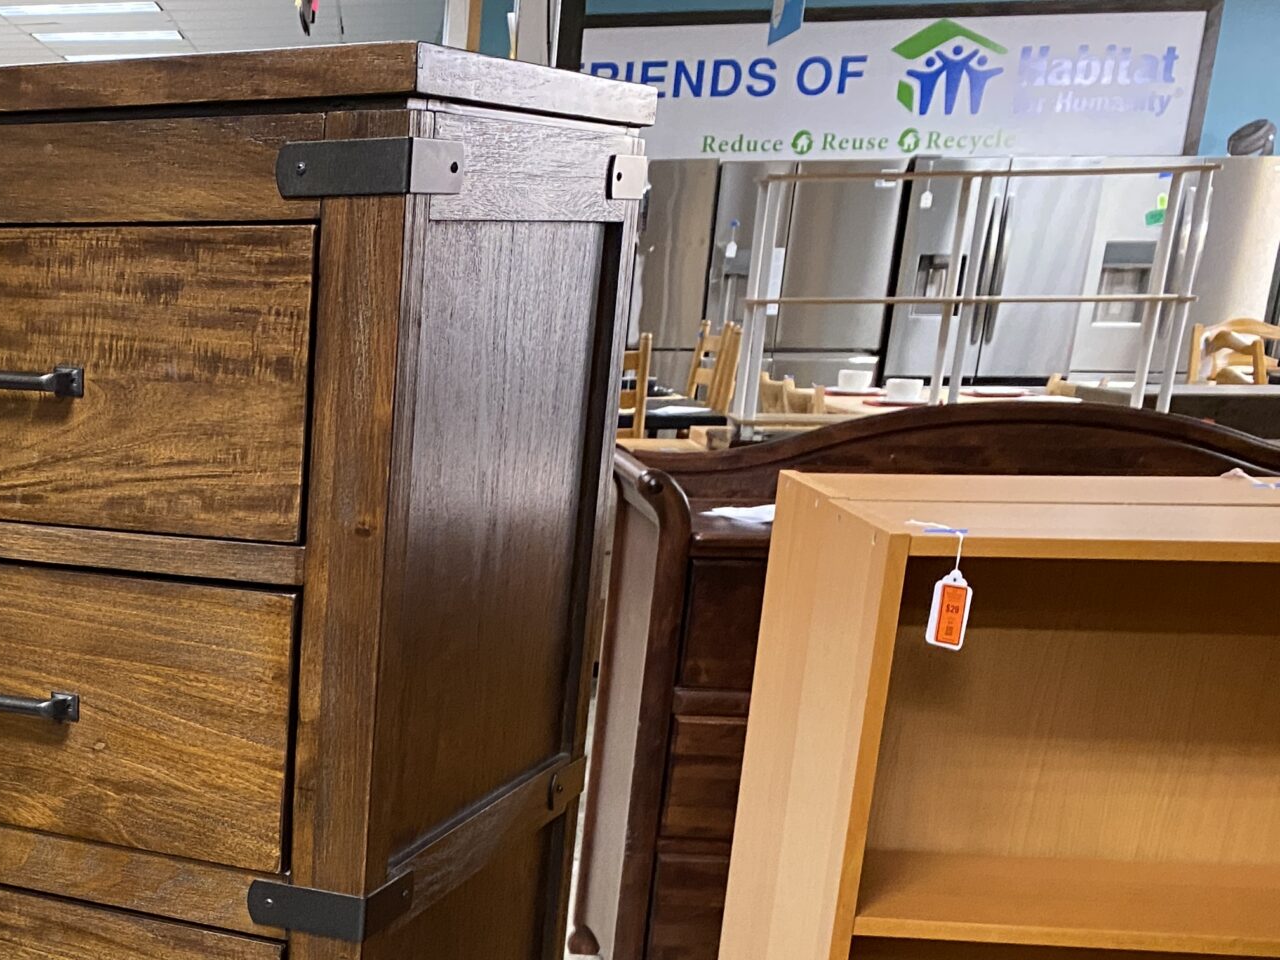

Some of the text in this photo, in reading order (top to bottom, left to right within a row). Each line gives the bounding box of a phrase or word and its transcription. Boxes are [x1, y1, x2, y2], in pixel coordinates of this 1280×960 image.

[578, 54, 868, 98] IENDS OF
[1019, 44, 1180, 87] Habitat
[701, 128, 1016, 154] Reduce Reuse Recycle
